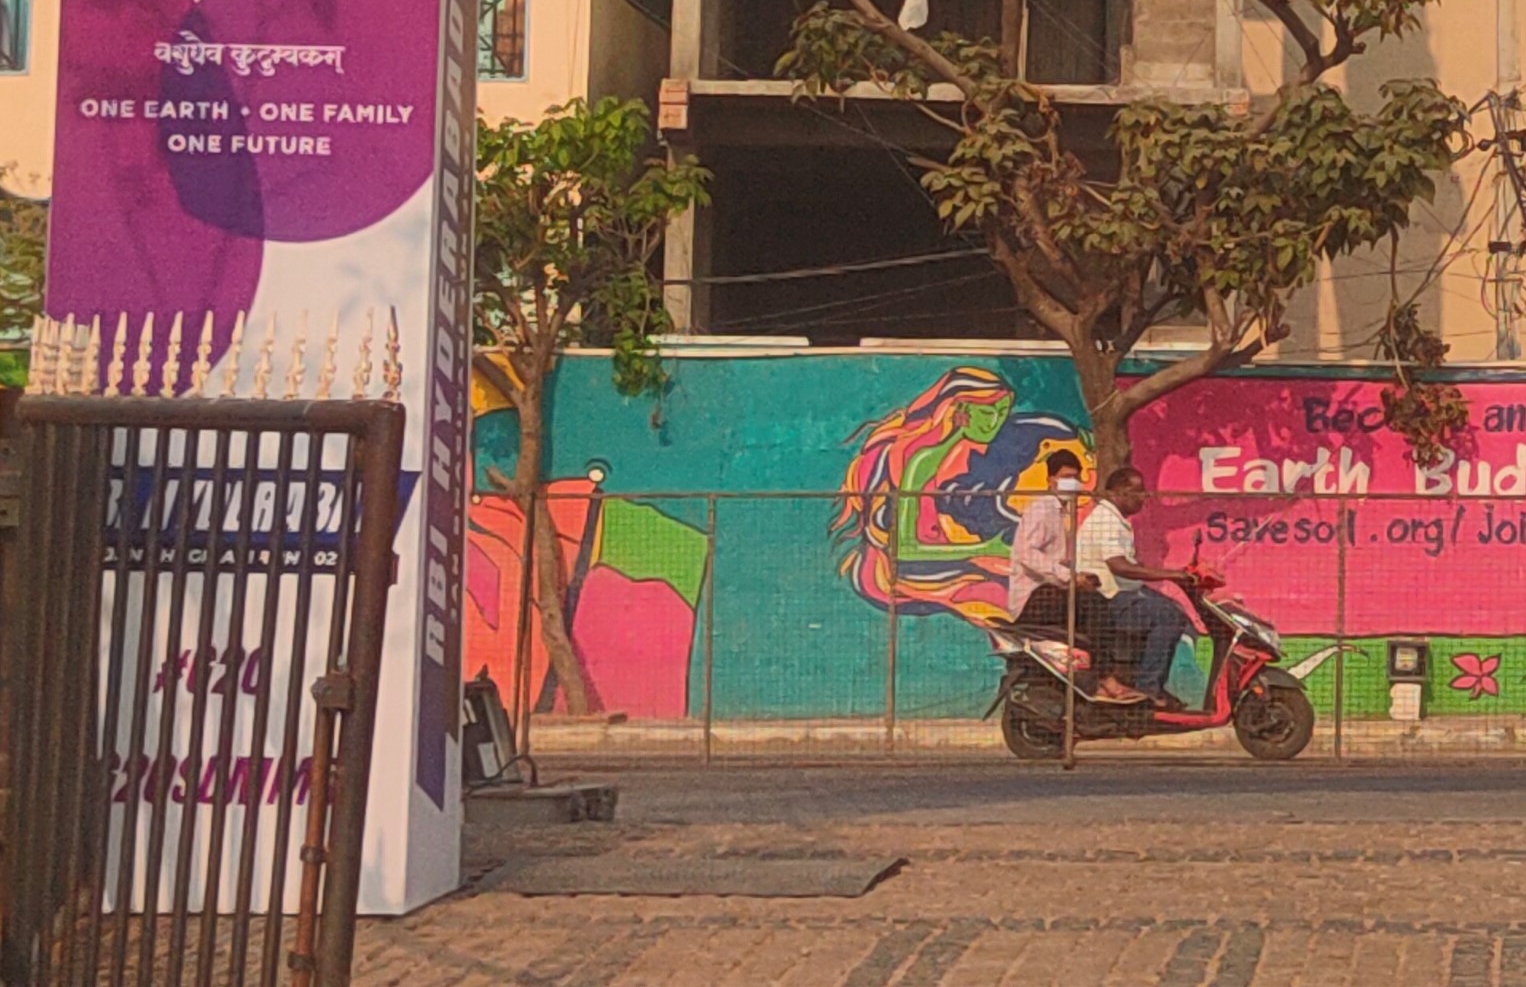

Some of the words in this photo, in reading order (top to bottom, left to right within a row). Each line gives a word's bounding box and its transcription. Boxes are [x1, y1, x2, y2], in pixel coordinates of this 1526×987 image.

[80, 98, 135, 119] ONE
[143, 99, 229, 120] EARTH
[260, 102, 315, 123] ONE
[323, 104, 414, 124] FAMILY
[167, 133, 222, 154] ONE
[231, 134, 332, 156] FUTURE
[1199, 445, 1372, 496] Earth
[425, 525, 448, 667] RBI
